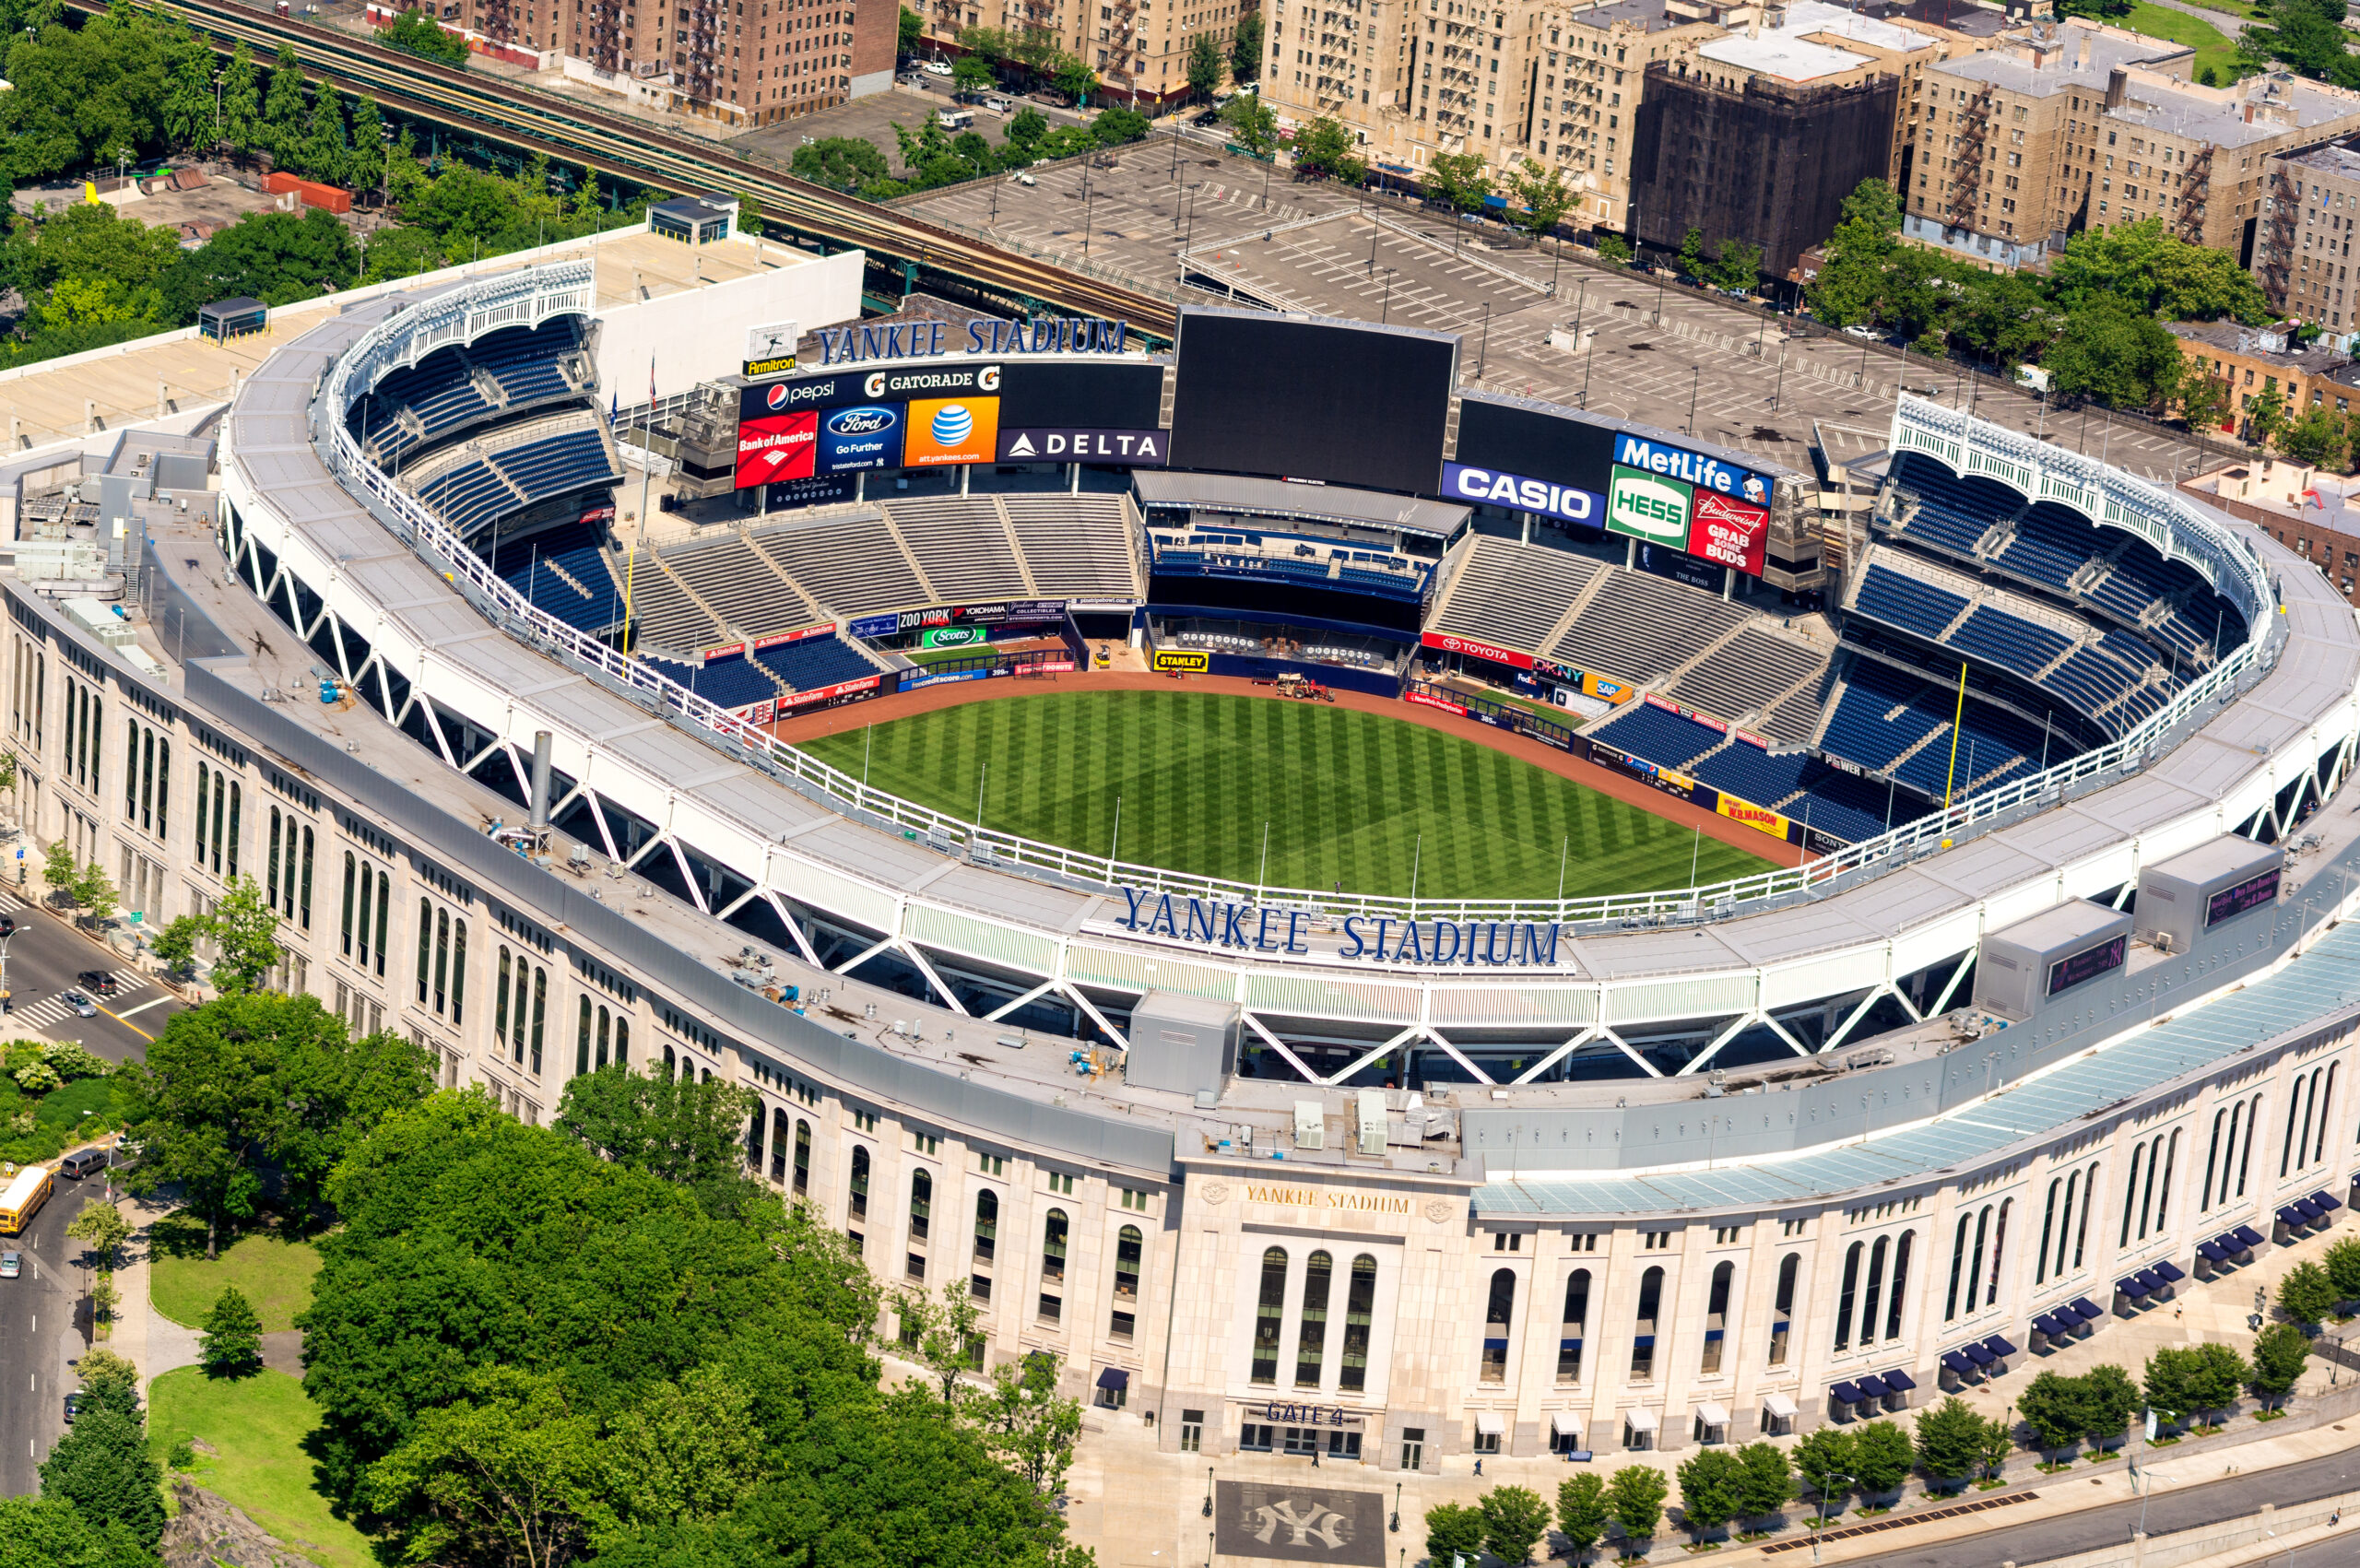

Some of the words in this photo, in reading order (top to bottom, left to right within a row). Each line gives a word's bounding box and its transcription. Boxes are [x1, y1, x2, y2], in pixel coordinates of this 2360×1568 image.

[815, 321, 946, 365] YANKEE
[965, 319, 1127, 355] STADIUM
[749, 358, 795, 375] Armitron
[890, 372, 973, 390] GATORADE
[791, 381, 834, 404] pepsi
[840, 412, 883, 432] Ford
[739, 437, 764, 452] Bank
[764, 434, 774, 447] of
[774, 430, 814, 445] America
[836, 445, 849, 454] Go
[851, 442, 883, 453] Further
[1046, 434, 1157, 457] DELTA
[832, 461, 873, 470] tristateford.com
[919, 454, 979, 464] att.yankees.com
[1622, 439, 1731, 492] MetLife
[1457, 468, 1591, 519] CASIO
[1617, 489, 1682, 525] HESS
[1697, 499, 1761, 528] Budweiser
[1707, 525, 1750, 548] GRAB
[1714, 538, 1740, 553] SOME
[1705, 543, 1747, 567] BUDS
[1676, 572, 1690, 582] THE
[1691, 575, 1708, 587] BOSS
[900, 612, 920, 628] ZOO
[922, 608, 950, 625] YORK
[965, 605, 1006, 615] YOKOHAMA
[938, 630, 970, 642] Scotts
[1160, 656, 1203, 666] STANLEY
[1462, 643, 1508, 661] TOYOTA
[1533, 658, 1584, 682] DKNY
[911, 674, 974, 690] freecreditscore.com
[1517, 673, 1537, 686] FedEx
[1597, 682, 1616, 695] SAP
[1647, 694, 1677, 712] MODELL'S
[1695, 713, 1725, 730] MODELL'S
[1737, 729, 1768, 747] MODELL'S
[1814, 832, 1845, 849] SONY
[1119, 885, 1311, 954] YANKEE
[1339, 912, 1563, 965] STADIUM
[1247, 1185, 1318, 1207] YANKEE
[1327, 1192, 1409, 1214] STADIUM
[1267, 1402, 1324, 1425] GATE
[1330, 1408, 1343, 1426] 4
